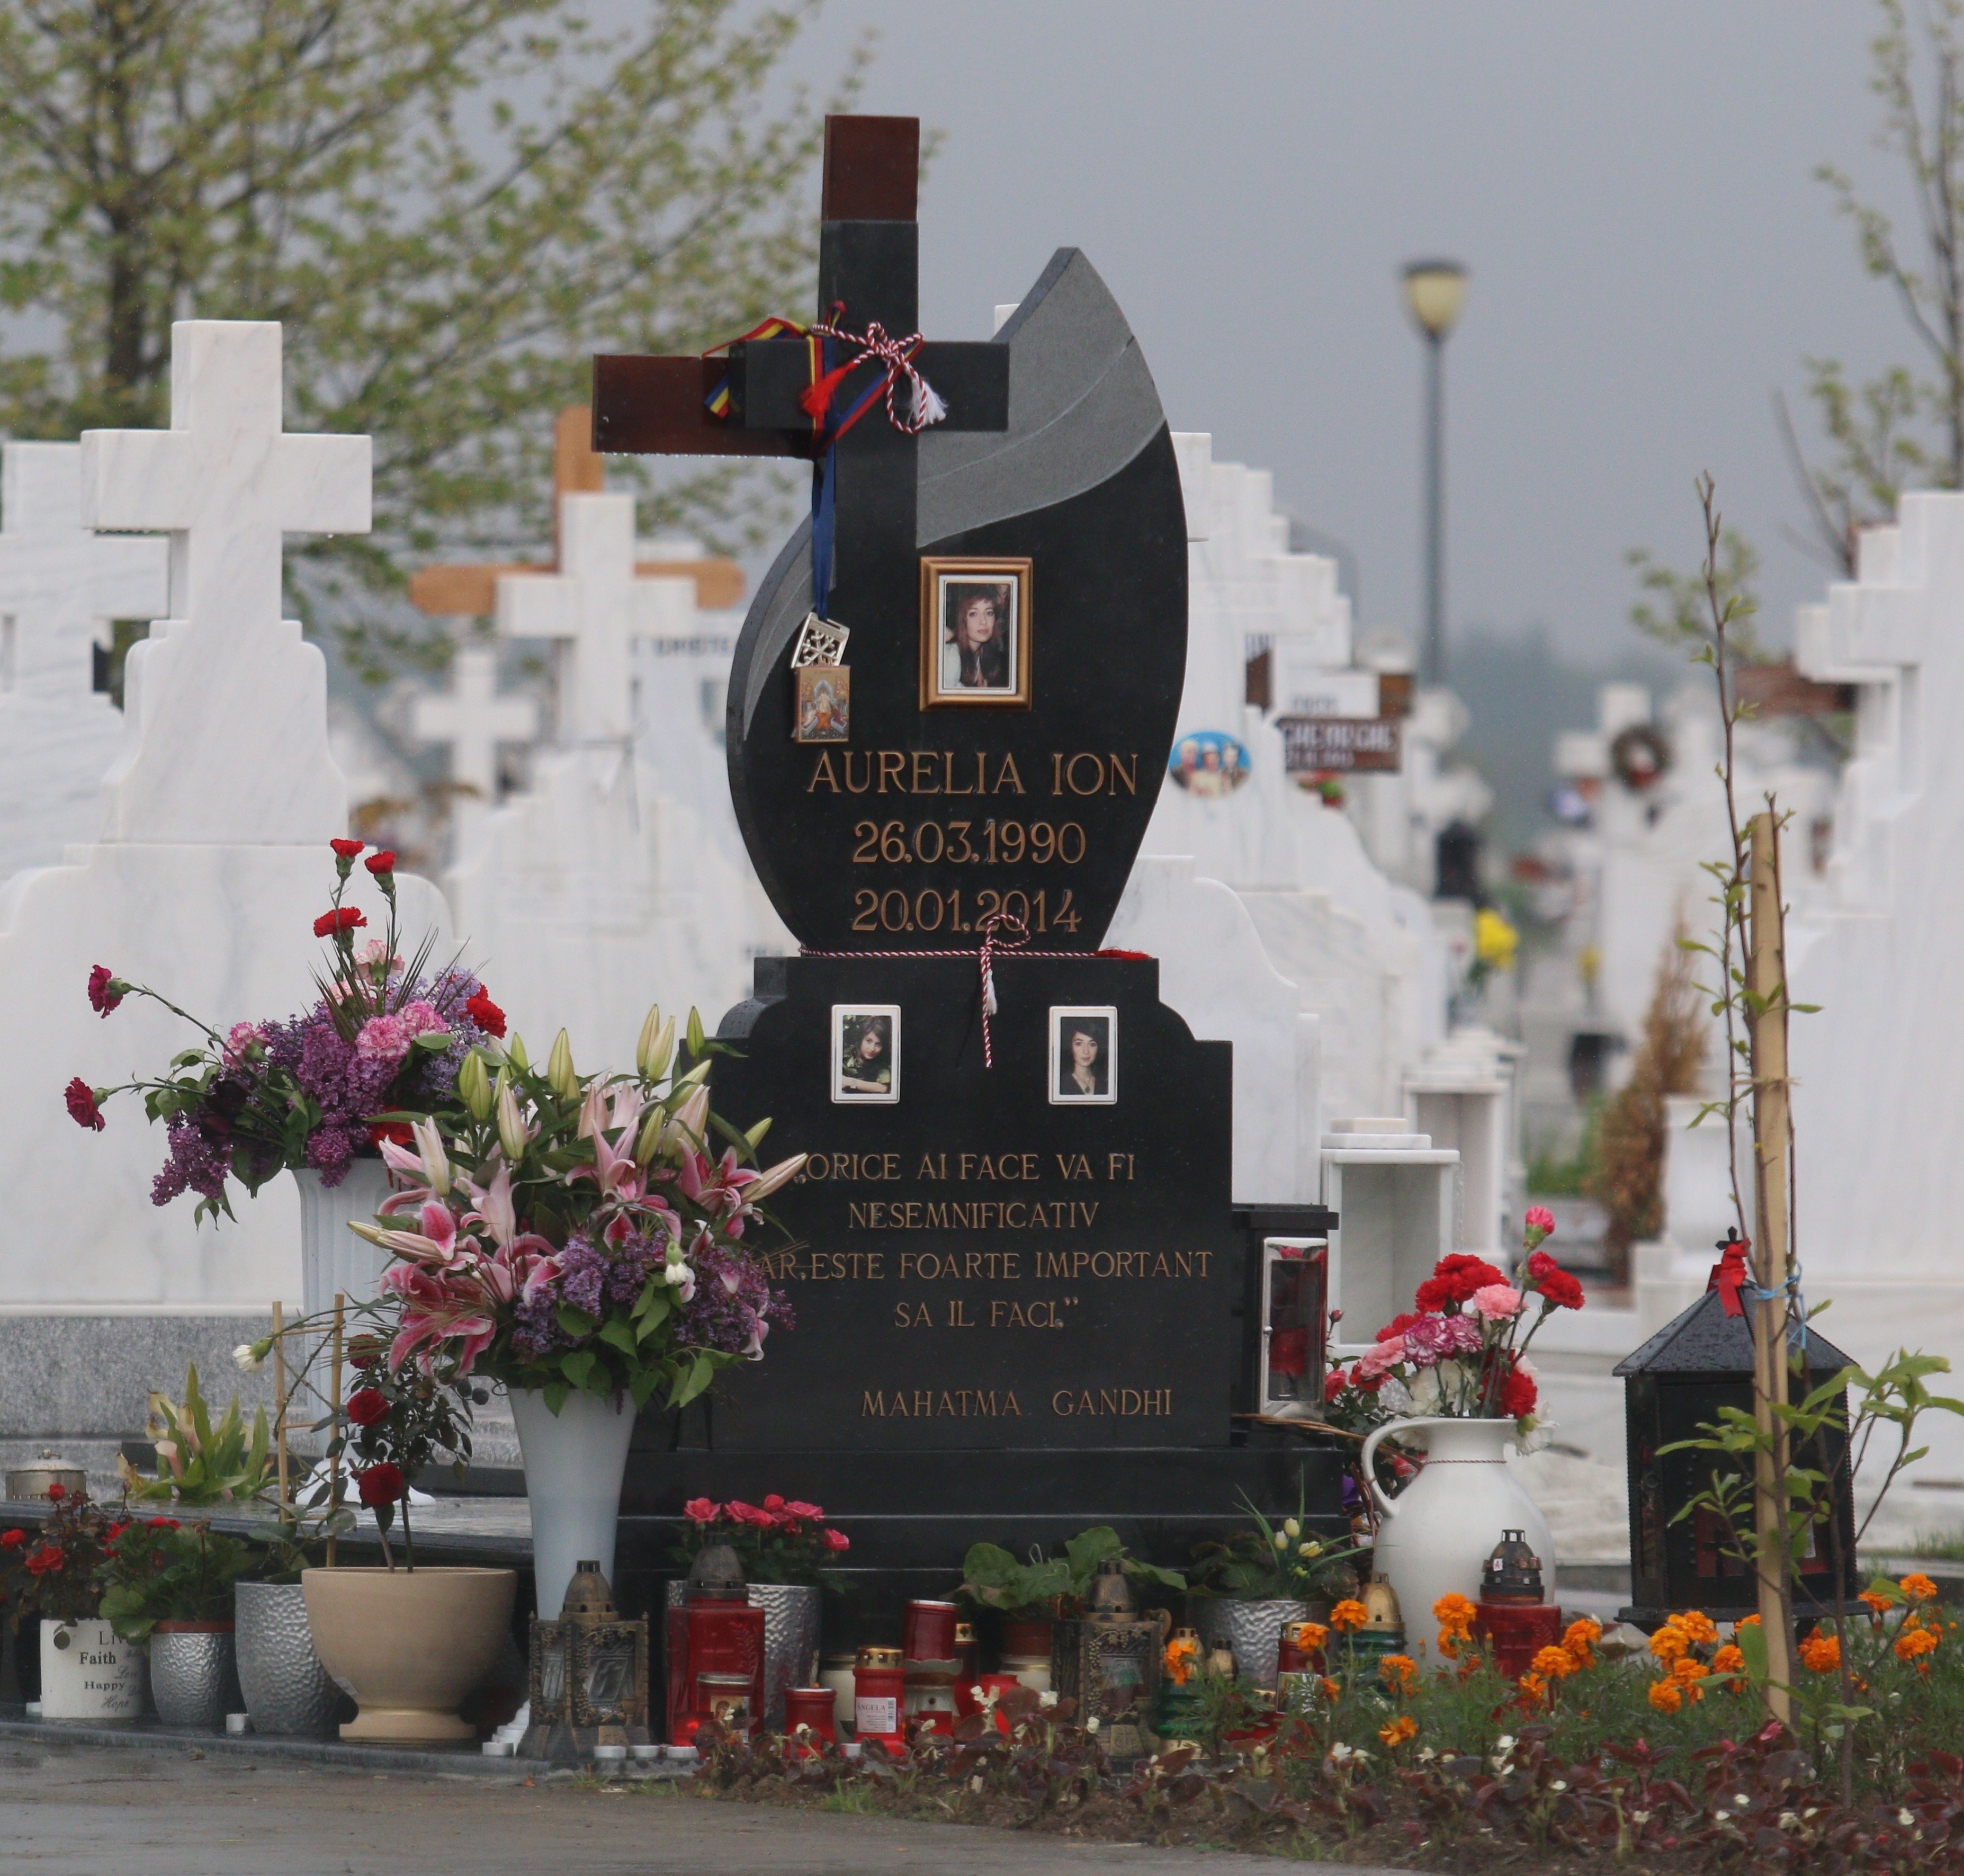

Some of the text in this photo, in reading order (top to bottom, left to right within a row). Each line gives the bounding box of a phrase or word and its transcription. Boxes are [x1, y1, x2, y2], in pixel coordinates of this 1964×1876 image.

[806, 750, 1138, 796] AURELIA ION
[852, 821, 1087, 864] 26.03.1990
[851, 890, 1082, 933] 20.01.2014
[917, 1154, 947, 1180] AI
[960, 1154, 1041, 1181] FACE
[1056, 1155, 1093, 1180] VA
[1108, 1155, 1135, 1181] FI
[849, 1202, 1100, 1229] NESEMNIFICATIV
[899, 1253, 1021, 1280] FOARTE
[1036, 1252, 1213, 1279] IMPORTANT
[895, 1302, 934, 1327] SA
[949, 1301, 975, 1327] IL
[861, 1389, 1172, 1417] MAHATMA GANDHI
[79, 1651, 116, 1665] Faith
[85, 1681, 125, 1691] Happy
